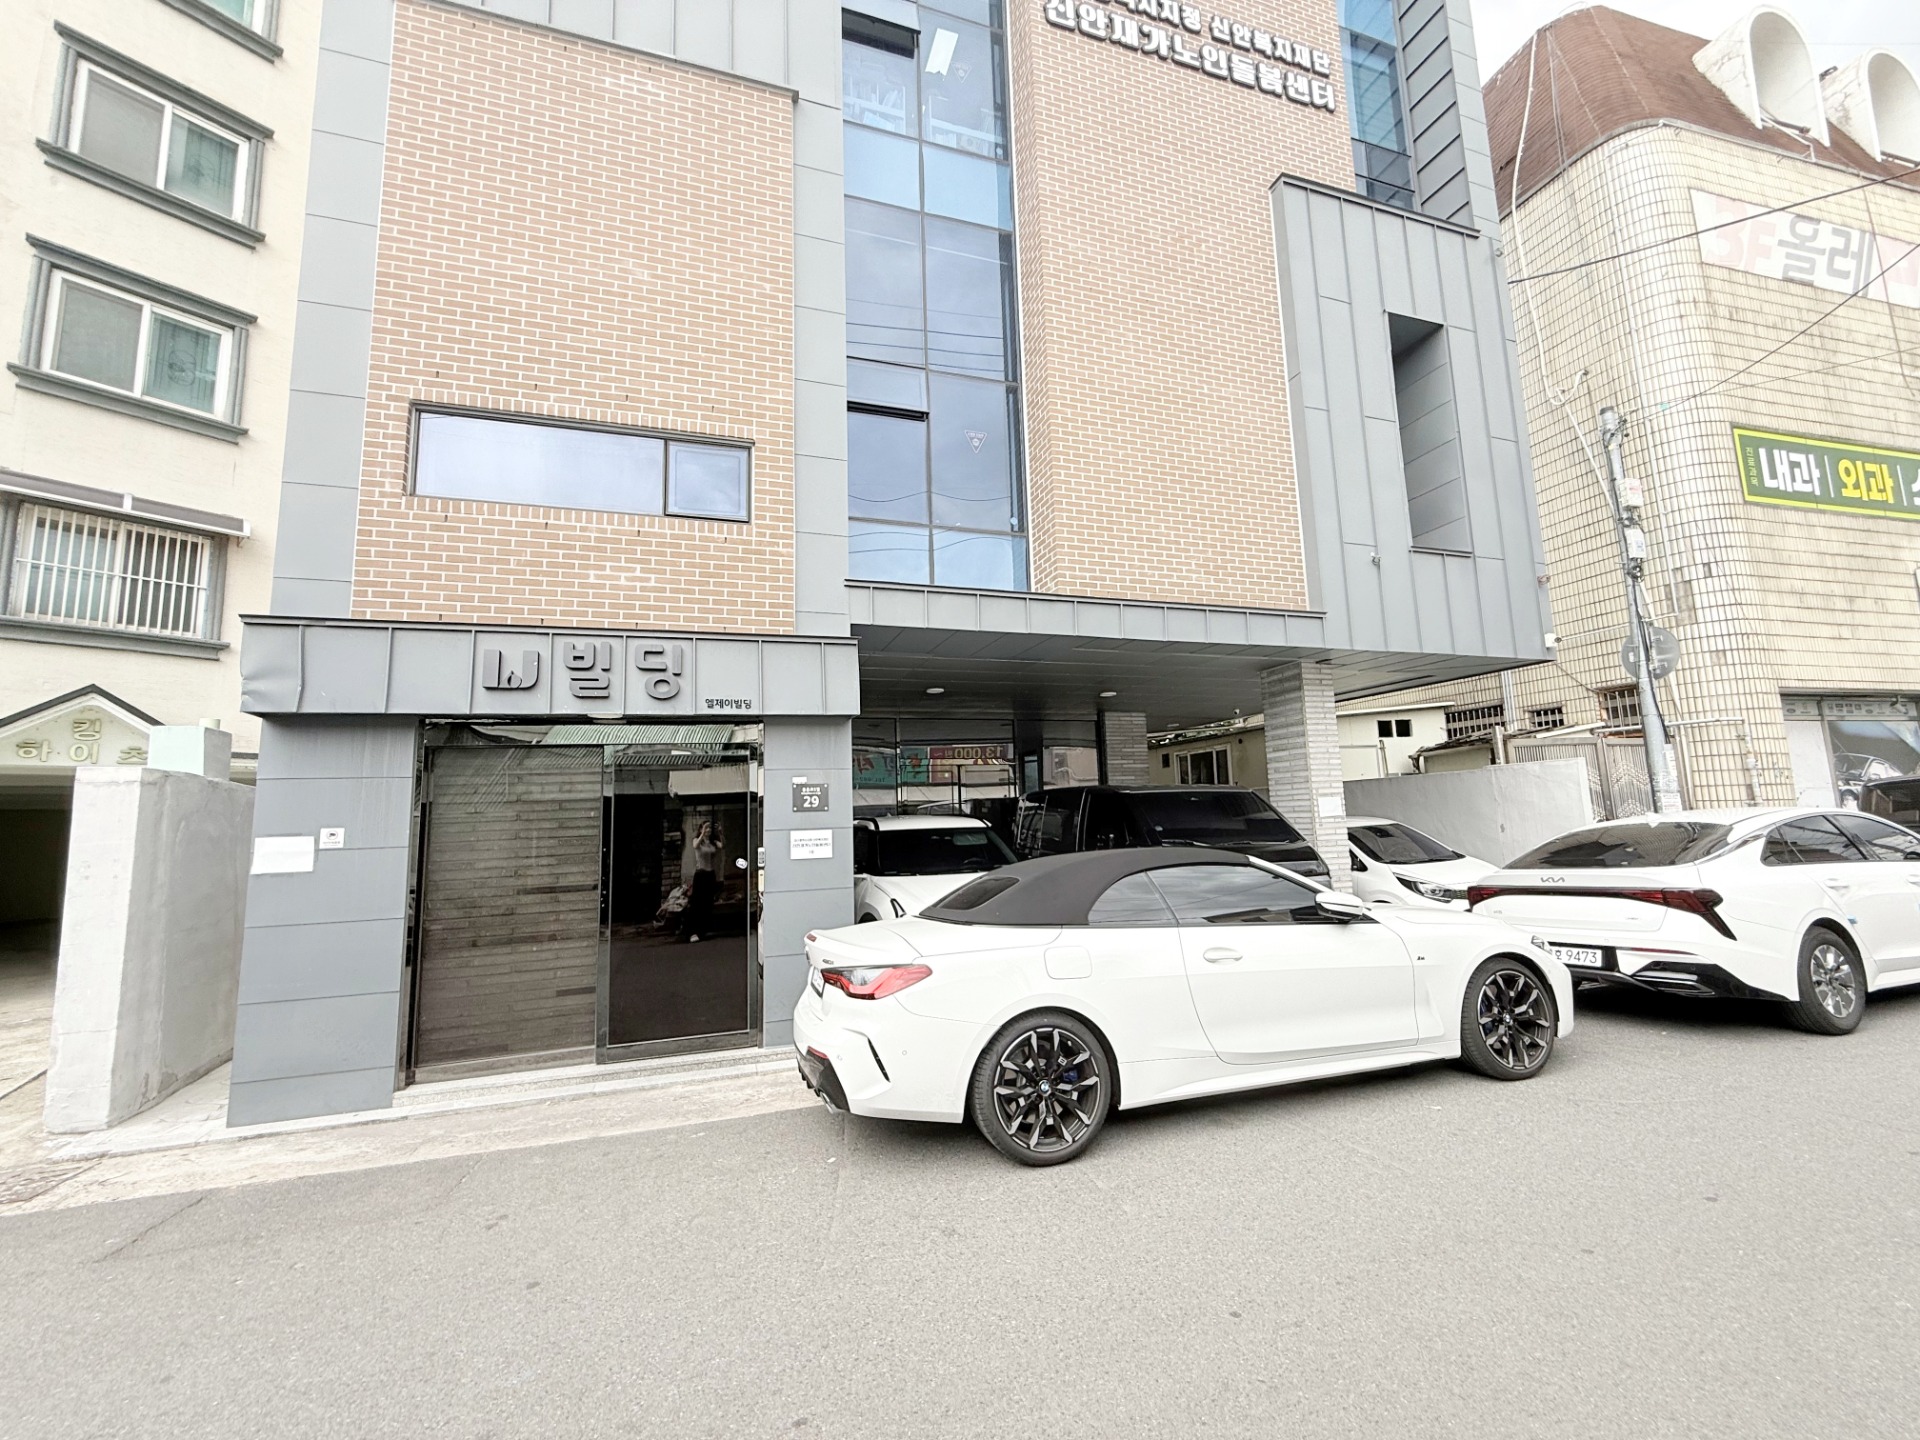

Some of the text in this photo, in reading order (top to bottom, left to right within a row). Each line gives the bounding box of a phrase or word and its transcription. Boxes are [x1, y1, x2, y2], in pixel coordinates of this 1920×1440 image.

[1045, 0, 1335, 112] 신안재가노인돌봄센터
[1210, 15, 1330, 75] 신안복지재단
[1777, 214, 1876, 298] 올레
[1759, 448, 1820, 495] 내과
[1838, 458, 1894, 504] 외과
[705, 698, 752, 709] 엘제이빌딩
[73, 718, 101, 741] 킹
[803, 796, 820, 807] 29
[1566, 950, 1597, 964] 9473
